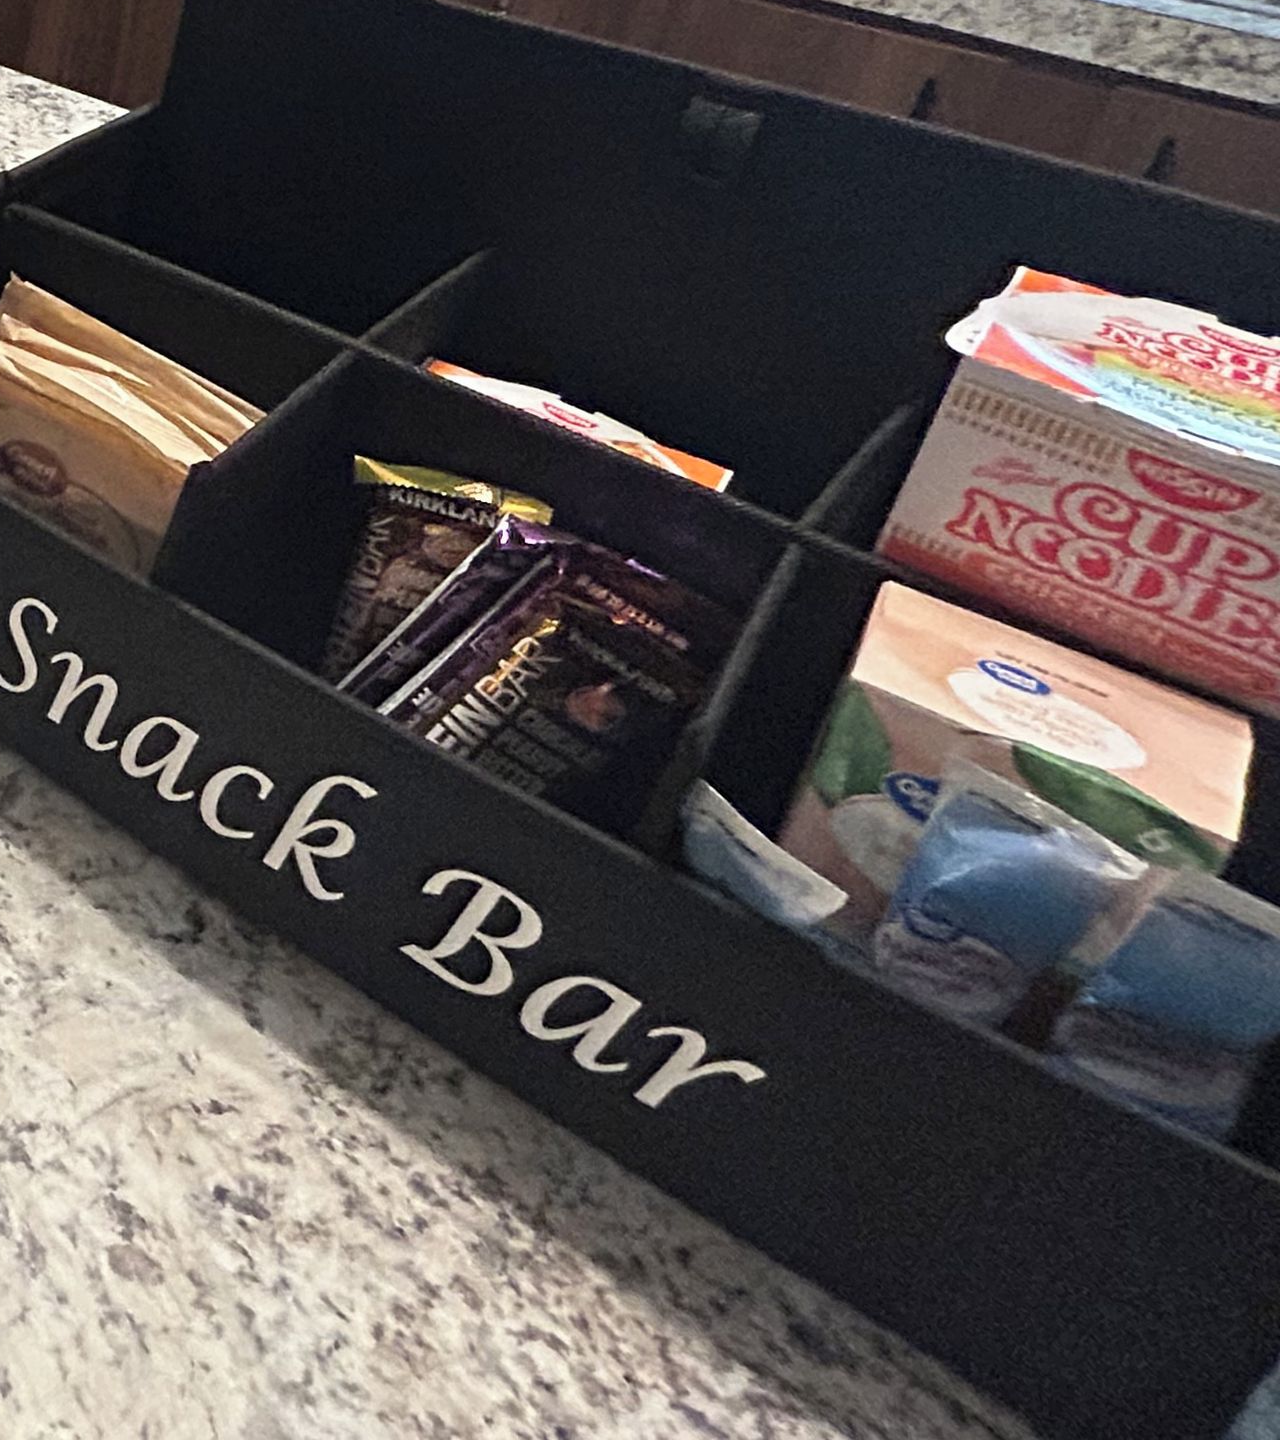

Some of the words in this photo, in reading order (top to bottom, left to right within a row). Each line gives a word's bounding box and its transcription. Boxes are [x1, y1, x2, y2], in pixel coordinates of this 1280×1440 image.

[389, 486, 498, 529] KIRKLAN
[1057, 483, 1278, 580] CUP
[474, 637, 562, 712] BAR
[399, 868, 766, 1109] Bar
